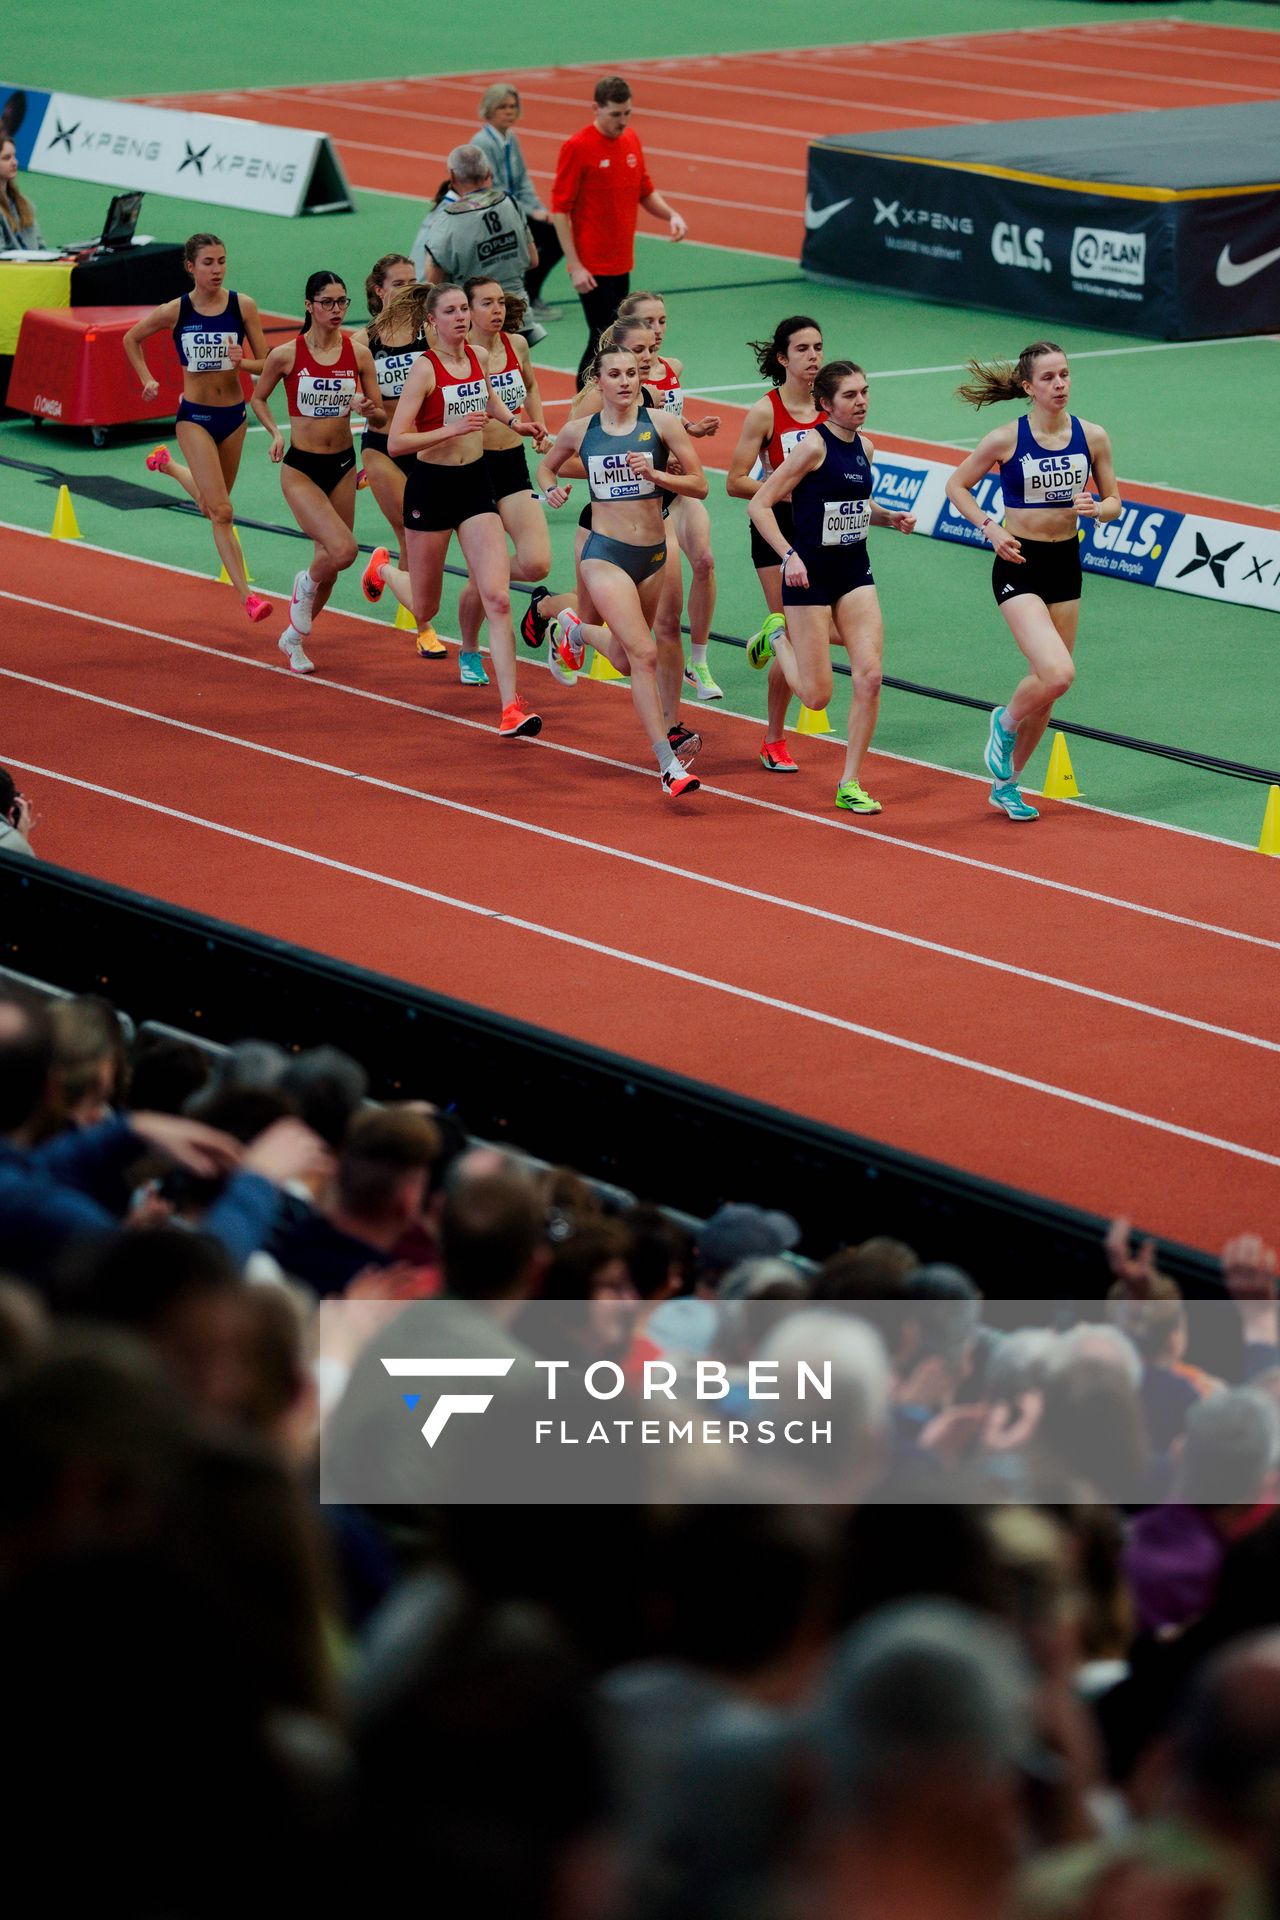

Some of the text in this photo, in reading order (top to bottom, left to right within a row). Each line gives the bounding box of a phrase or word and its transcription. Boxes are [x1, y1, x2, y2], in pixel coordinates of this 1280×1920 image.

[80, 131, 162, 161] XPENG
[211, 152, 298, 184] XPENG
[482, 211, 502, 235] 18
[902, 208, 974, 235] XPENG
[1102, 241, 1140, 264] PLAN
[301, 391, 353, 407] WOLFF LÓPEZ
[622, 485, 639, 493] PLAN
[877, 472, 922, 500] PLAN
[1032, 470, 1082, 489] BUDDE
[963, 527, 972, 538] to
[1083, 552, 1144, 575] Parcels to People
